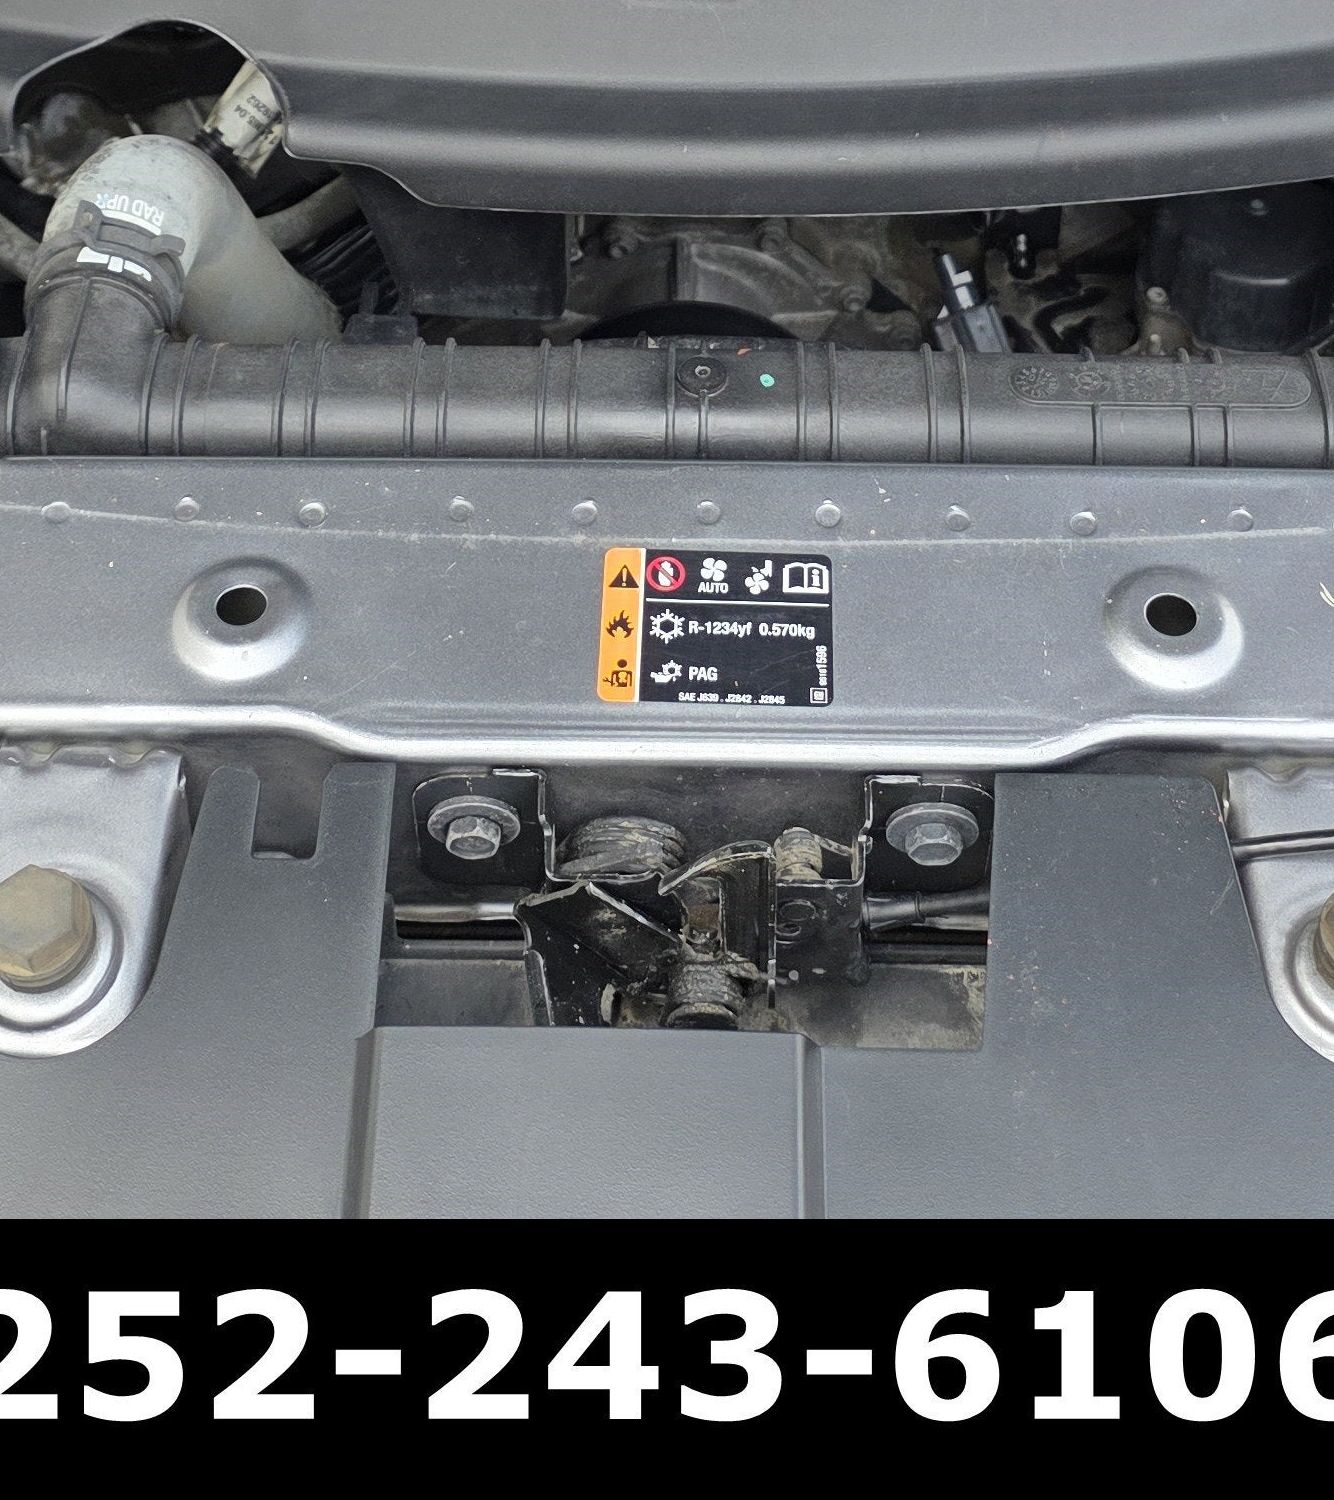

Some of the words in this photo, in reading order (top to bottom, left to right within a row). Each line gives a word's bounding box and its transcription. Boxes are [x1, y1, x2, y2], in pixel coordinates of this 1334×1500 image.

[131, 197, 165, 227] RAD
[697, 581, 729, 594] AUTO
[688, 622, 752, 638] R-1234yf
[758, 623, 816, 640] 0.570kg
[688, 666, 718, 682] PAG
[678, 691, 696, 703] SAE
